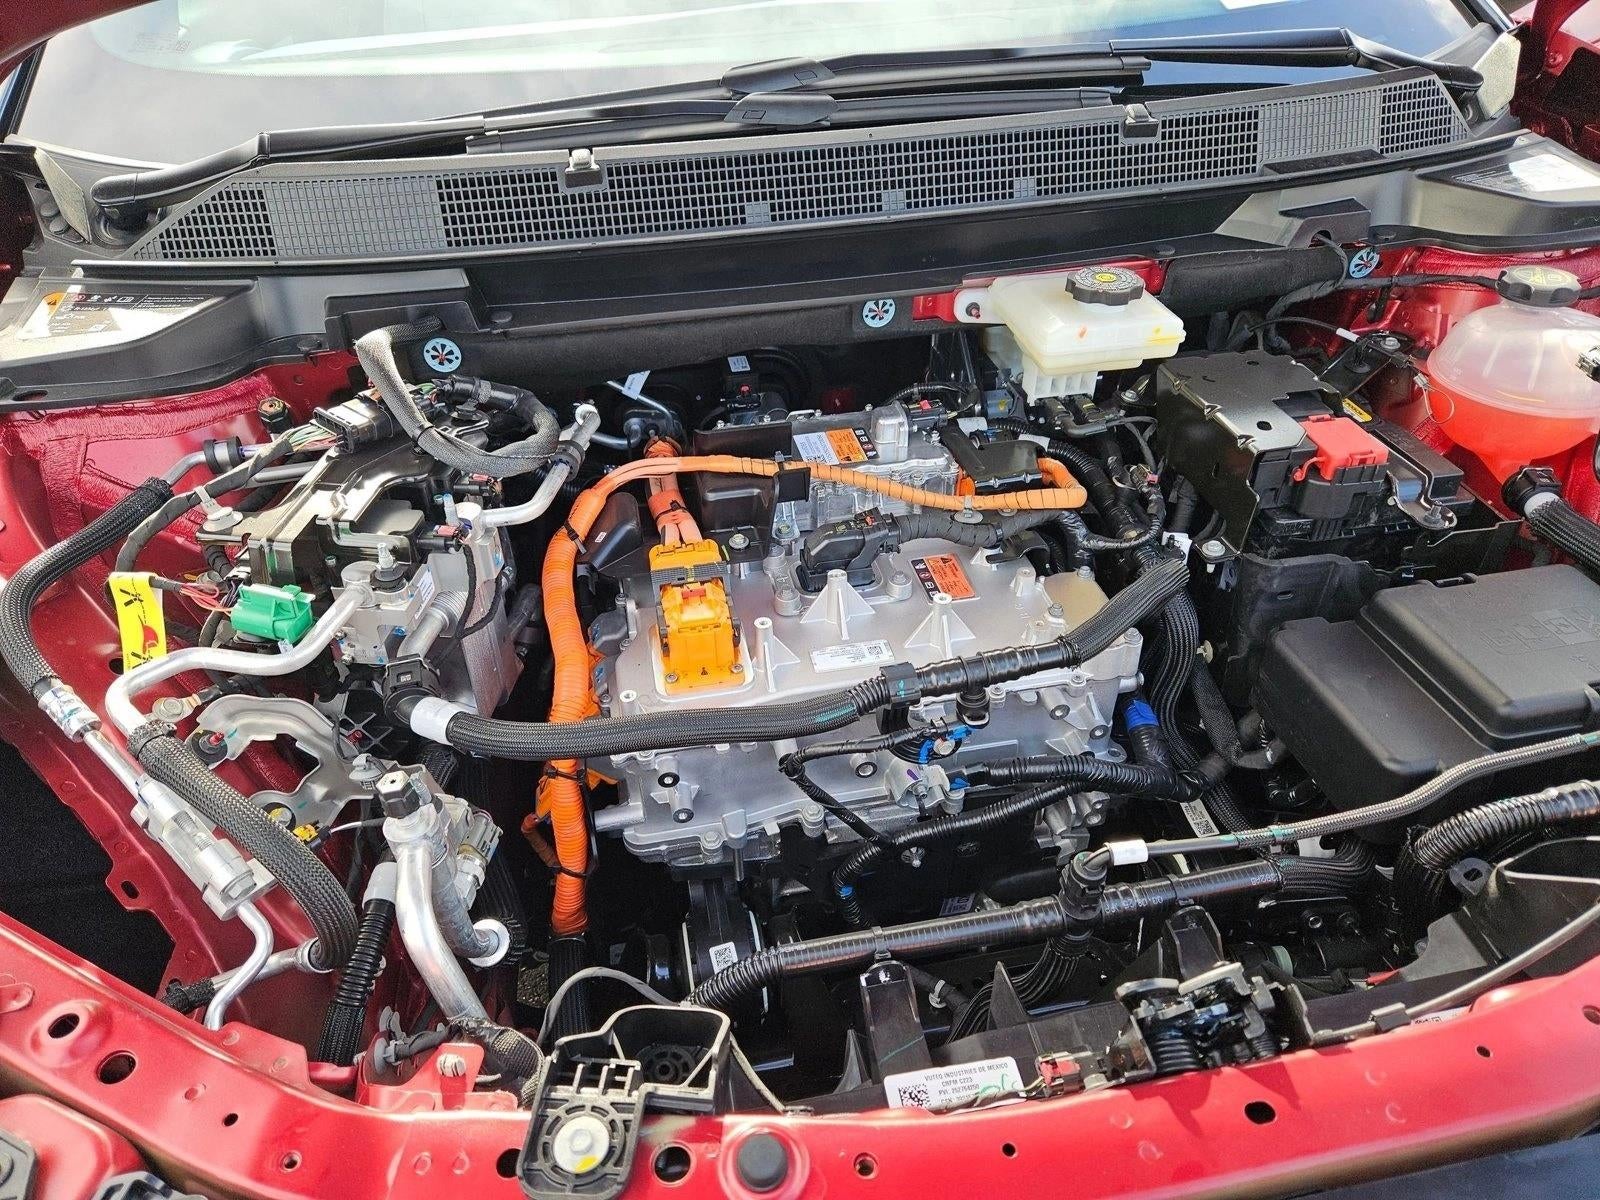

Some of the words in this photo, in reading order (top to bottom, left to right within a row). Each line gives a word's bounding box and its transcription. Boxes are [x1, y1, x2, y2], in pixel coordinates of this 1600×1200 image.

[944, 1067, 978, 1079] INDUSTRIES
[978, 1065, 986, 1073] DE
[987, 1062, 1009, 1071] MEXICO
